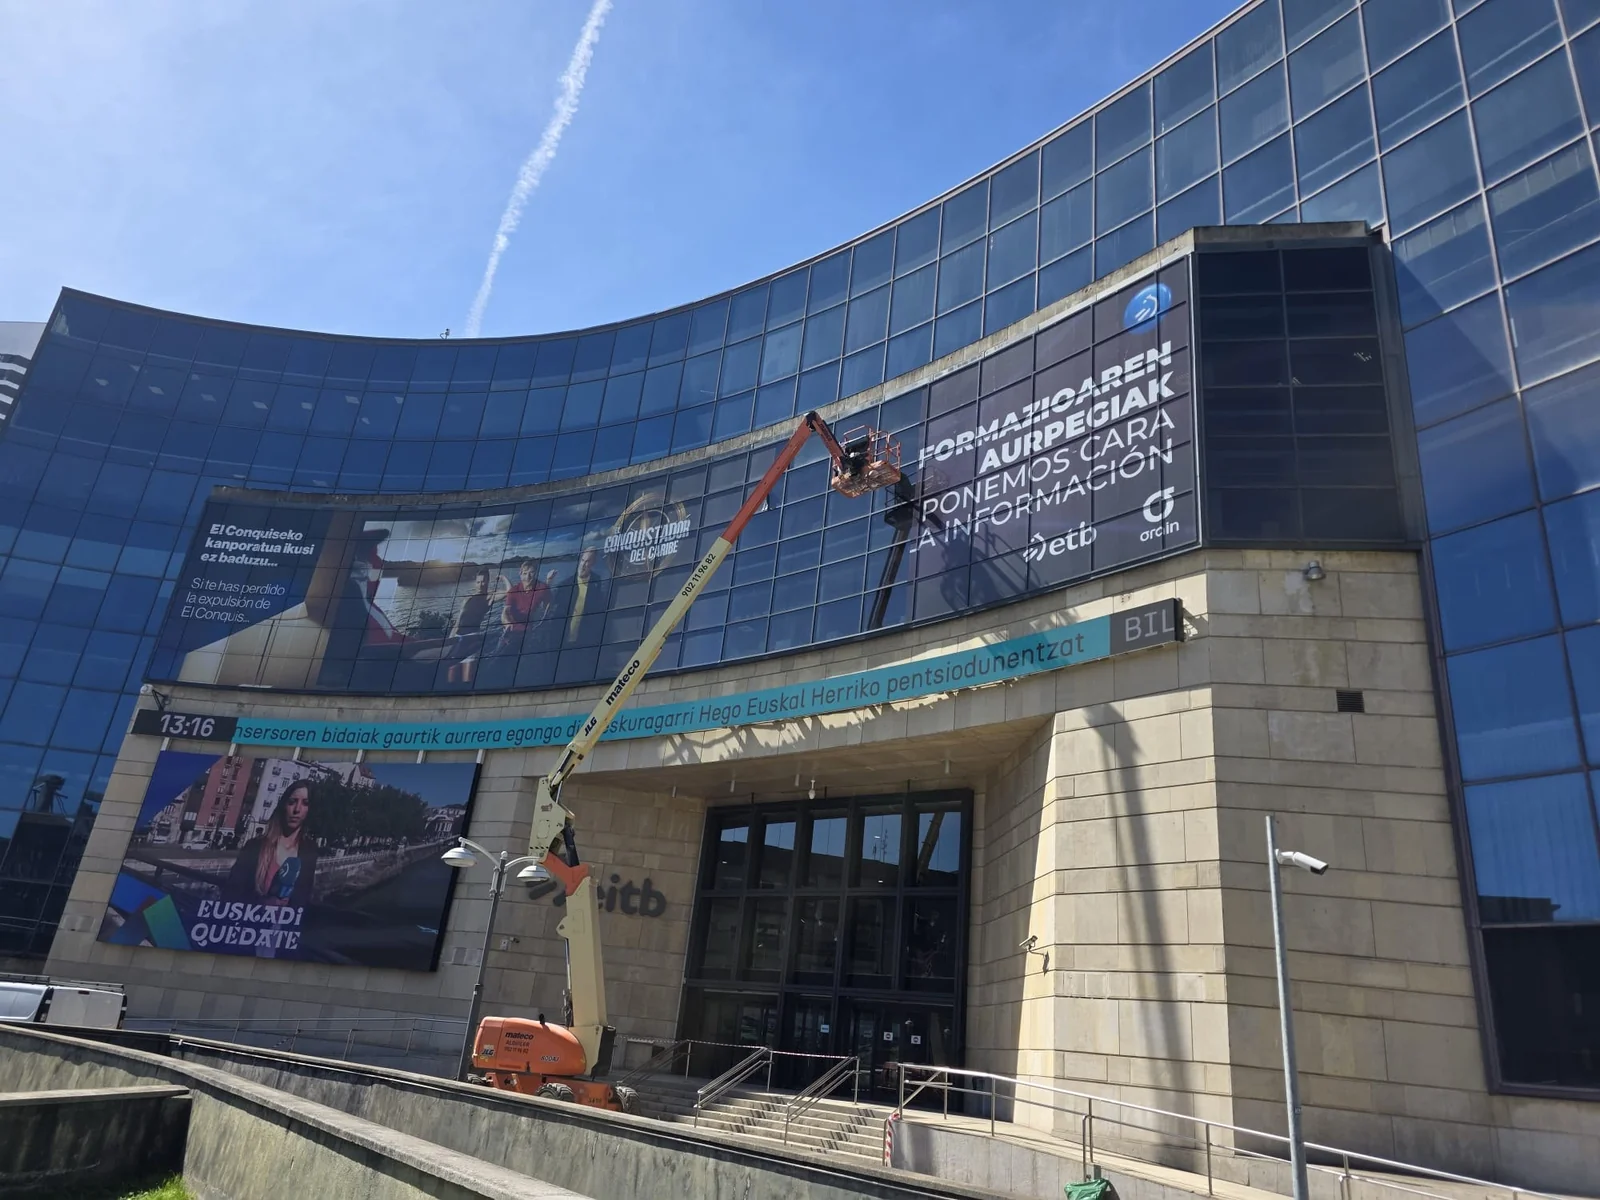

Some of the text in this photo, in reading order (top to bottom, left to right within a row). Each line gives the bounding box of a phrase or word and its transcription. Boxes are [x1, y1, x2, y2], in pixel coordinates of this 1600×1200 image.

[918, 340, 1172, 470] FORMAZIOAREN
[979, 370, 1175, 474] AURPEGIAK
[922, 408, 1175, 522] PONEMOS CARA
[909, 437, 1173, 554] A INFORMACIÓN
[209, 523, 303, 541] El Conquiseko
[603, 519, 691, 554] CONQUISTADOR
[1049, 521, 1097, 556] etb
[204, 537, 315, 555] kanporatua ikusi
[629, 540, 679, 563] DEL CARIBE
[200, 552, 278, 567] ez baduzu...
[191, 577, 286, 596] Si te has perdido
[681, 553, 716, 597] 902 11 96 82
[180, 605, 195, 618] El
[185, 591, 271, 610] la expulsión de
[321, 726, 380, 745] bidaiak
[382, 728, 440, 748] gaurtik
[445, 729, 501, 745] aurrera
[506, 725, 562, 745] egongo
[699, 703, 742, 728] Hego
[746, 687, 805, 717] Euskal
[810, 677, 881, 706] Herriko
[886, 632, 1085, 700] pentsiodunentzat
[605, 659, 640, 706] mateco
[160, 713, 216, 737] 13:16
[584, 716, 598, 737] JLG
[190, 921, 301, 950] QUÉDATE
[504, 1031, 535, 1040] mateco
